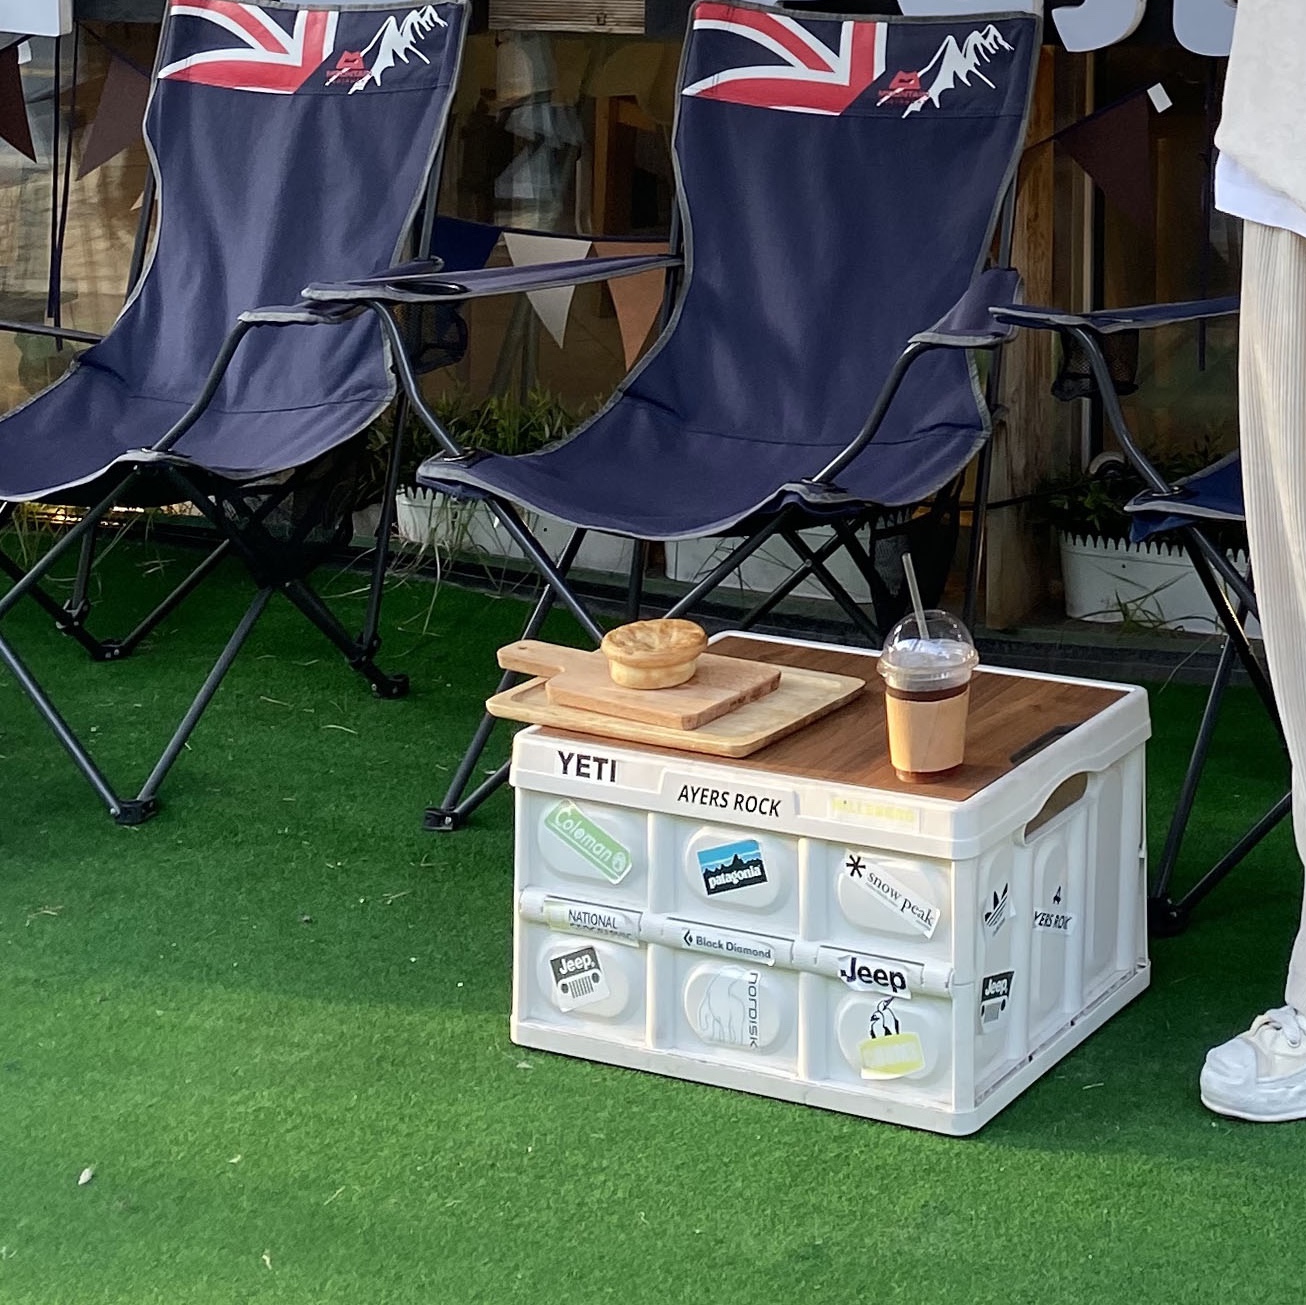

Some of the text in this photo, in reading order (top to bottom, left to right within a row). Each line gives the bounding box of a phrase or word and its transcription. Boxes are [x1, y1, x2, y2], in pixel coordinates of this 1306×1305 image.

[558, 751, 617, 783] YETI
[677, 784, 782, 818] AYERS ROCK
[708, 863, 762, 890] patagonia
[867, 871, 902, 901] snow
[900, 897, 936, 927] peak
[568, 909, 618, 930] NATIONAL
[696, 935, 772, 959] Black Diamond
[840, 957, 907, 993] Jeep
